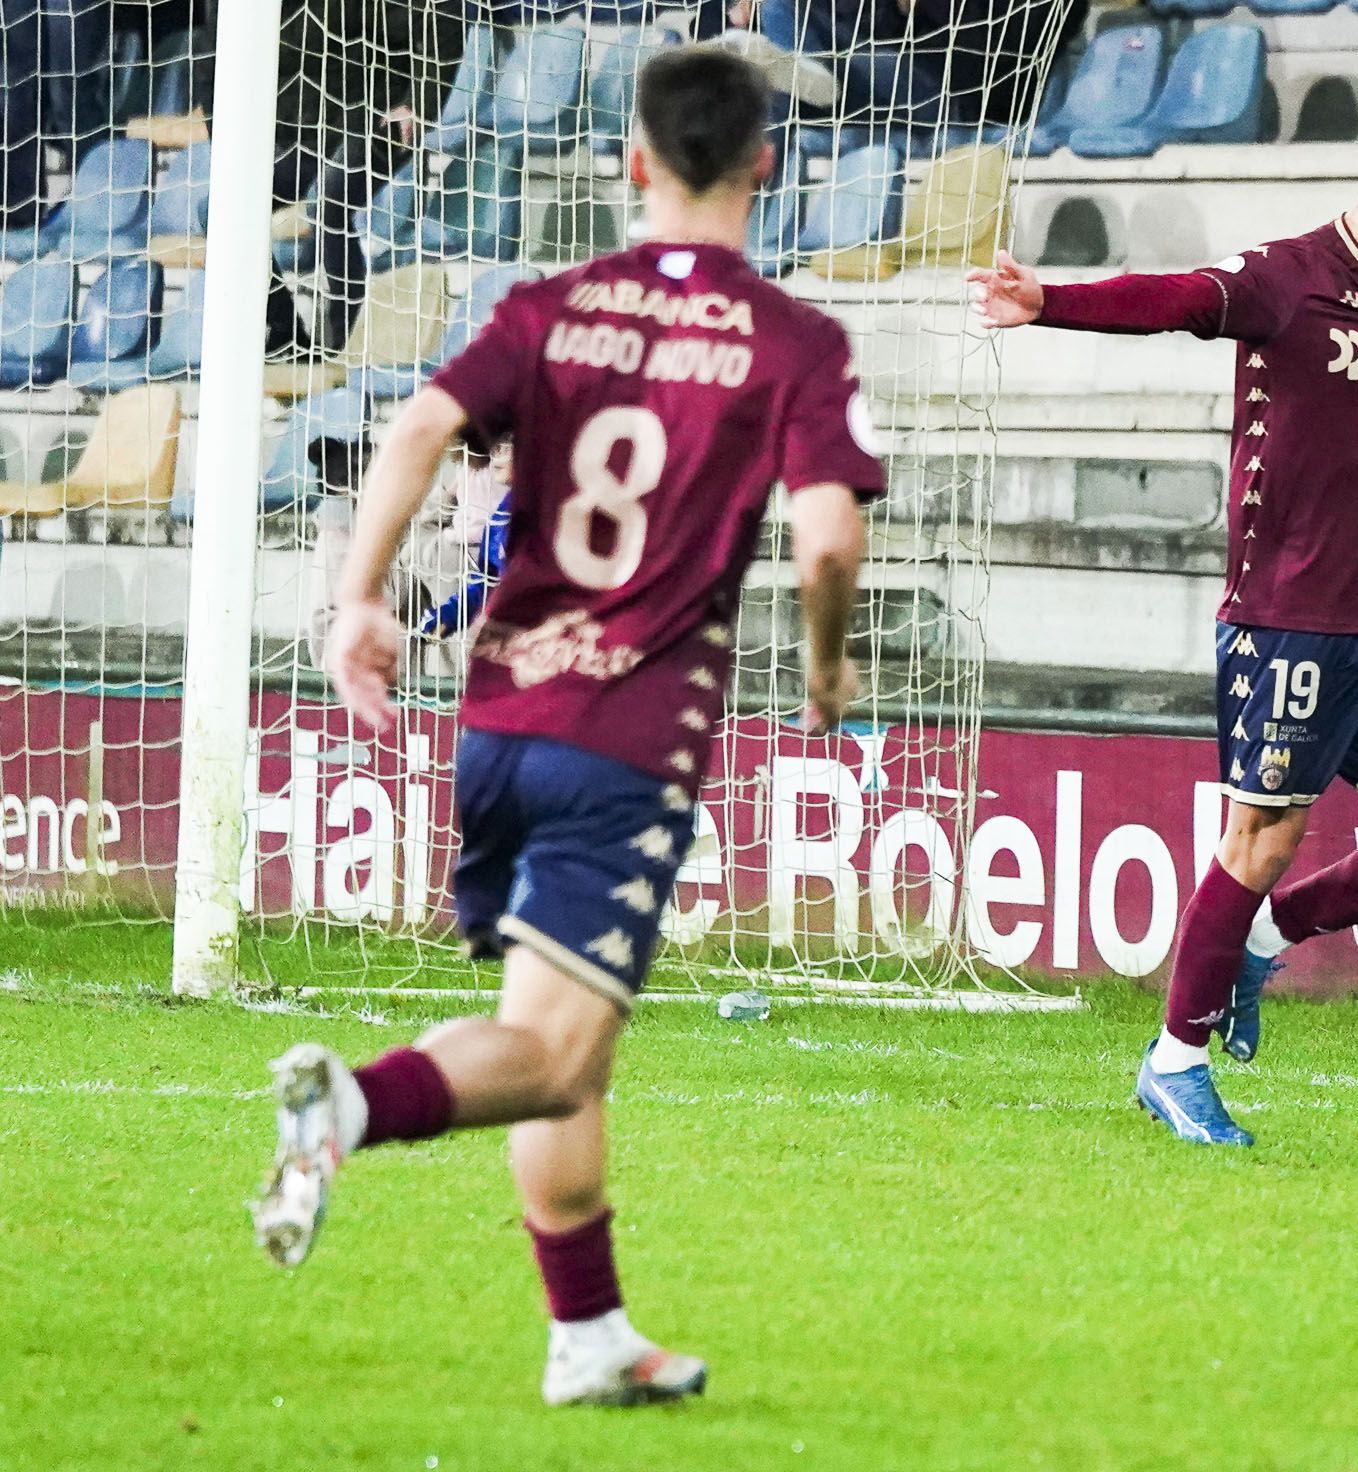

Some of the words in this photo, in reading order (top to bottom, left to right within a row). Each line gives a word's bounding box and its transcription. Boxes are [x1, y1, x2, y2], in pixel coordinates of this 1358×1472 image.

[544, 320, 645, 374] IAGO
[643, 338, 753, 389] NOVO
[552, 406, 667, 590] 8
[1269, 658, 1321, 720] 19
[0, 793, 121, 876] ence
